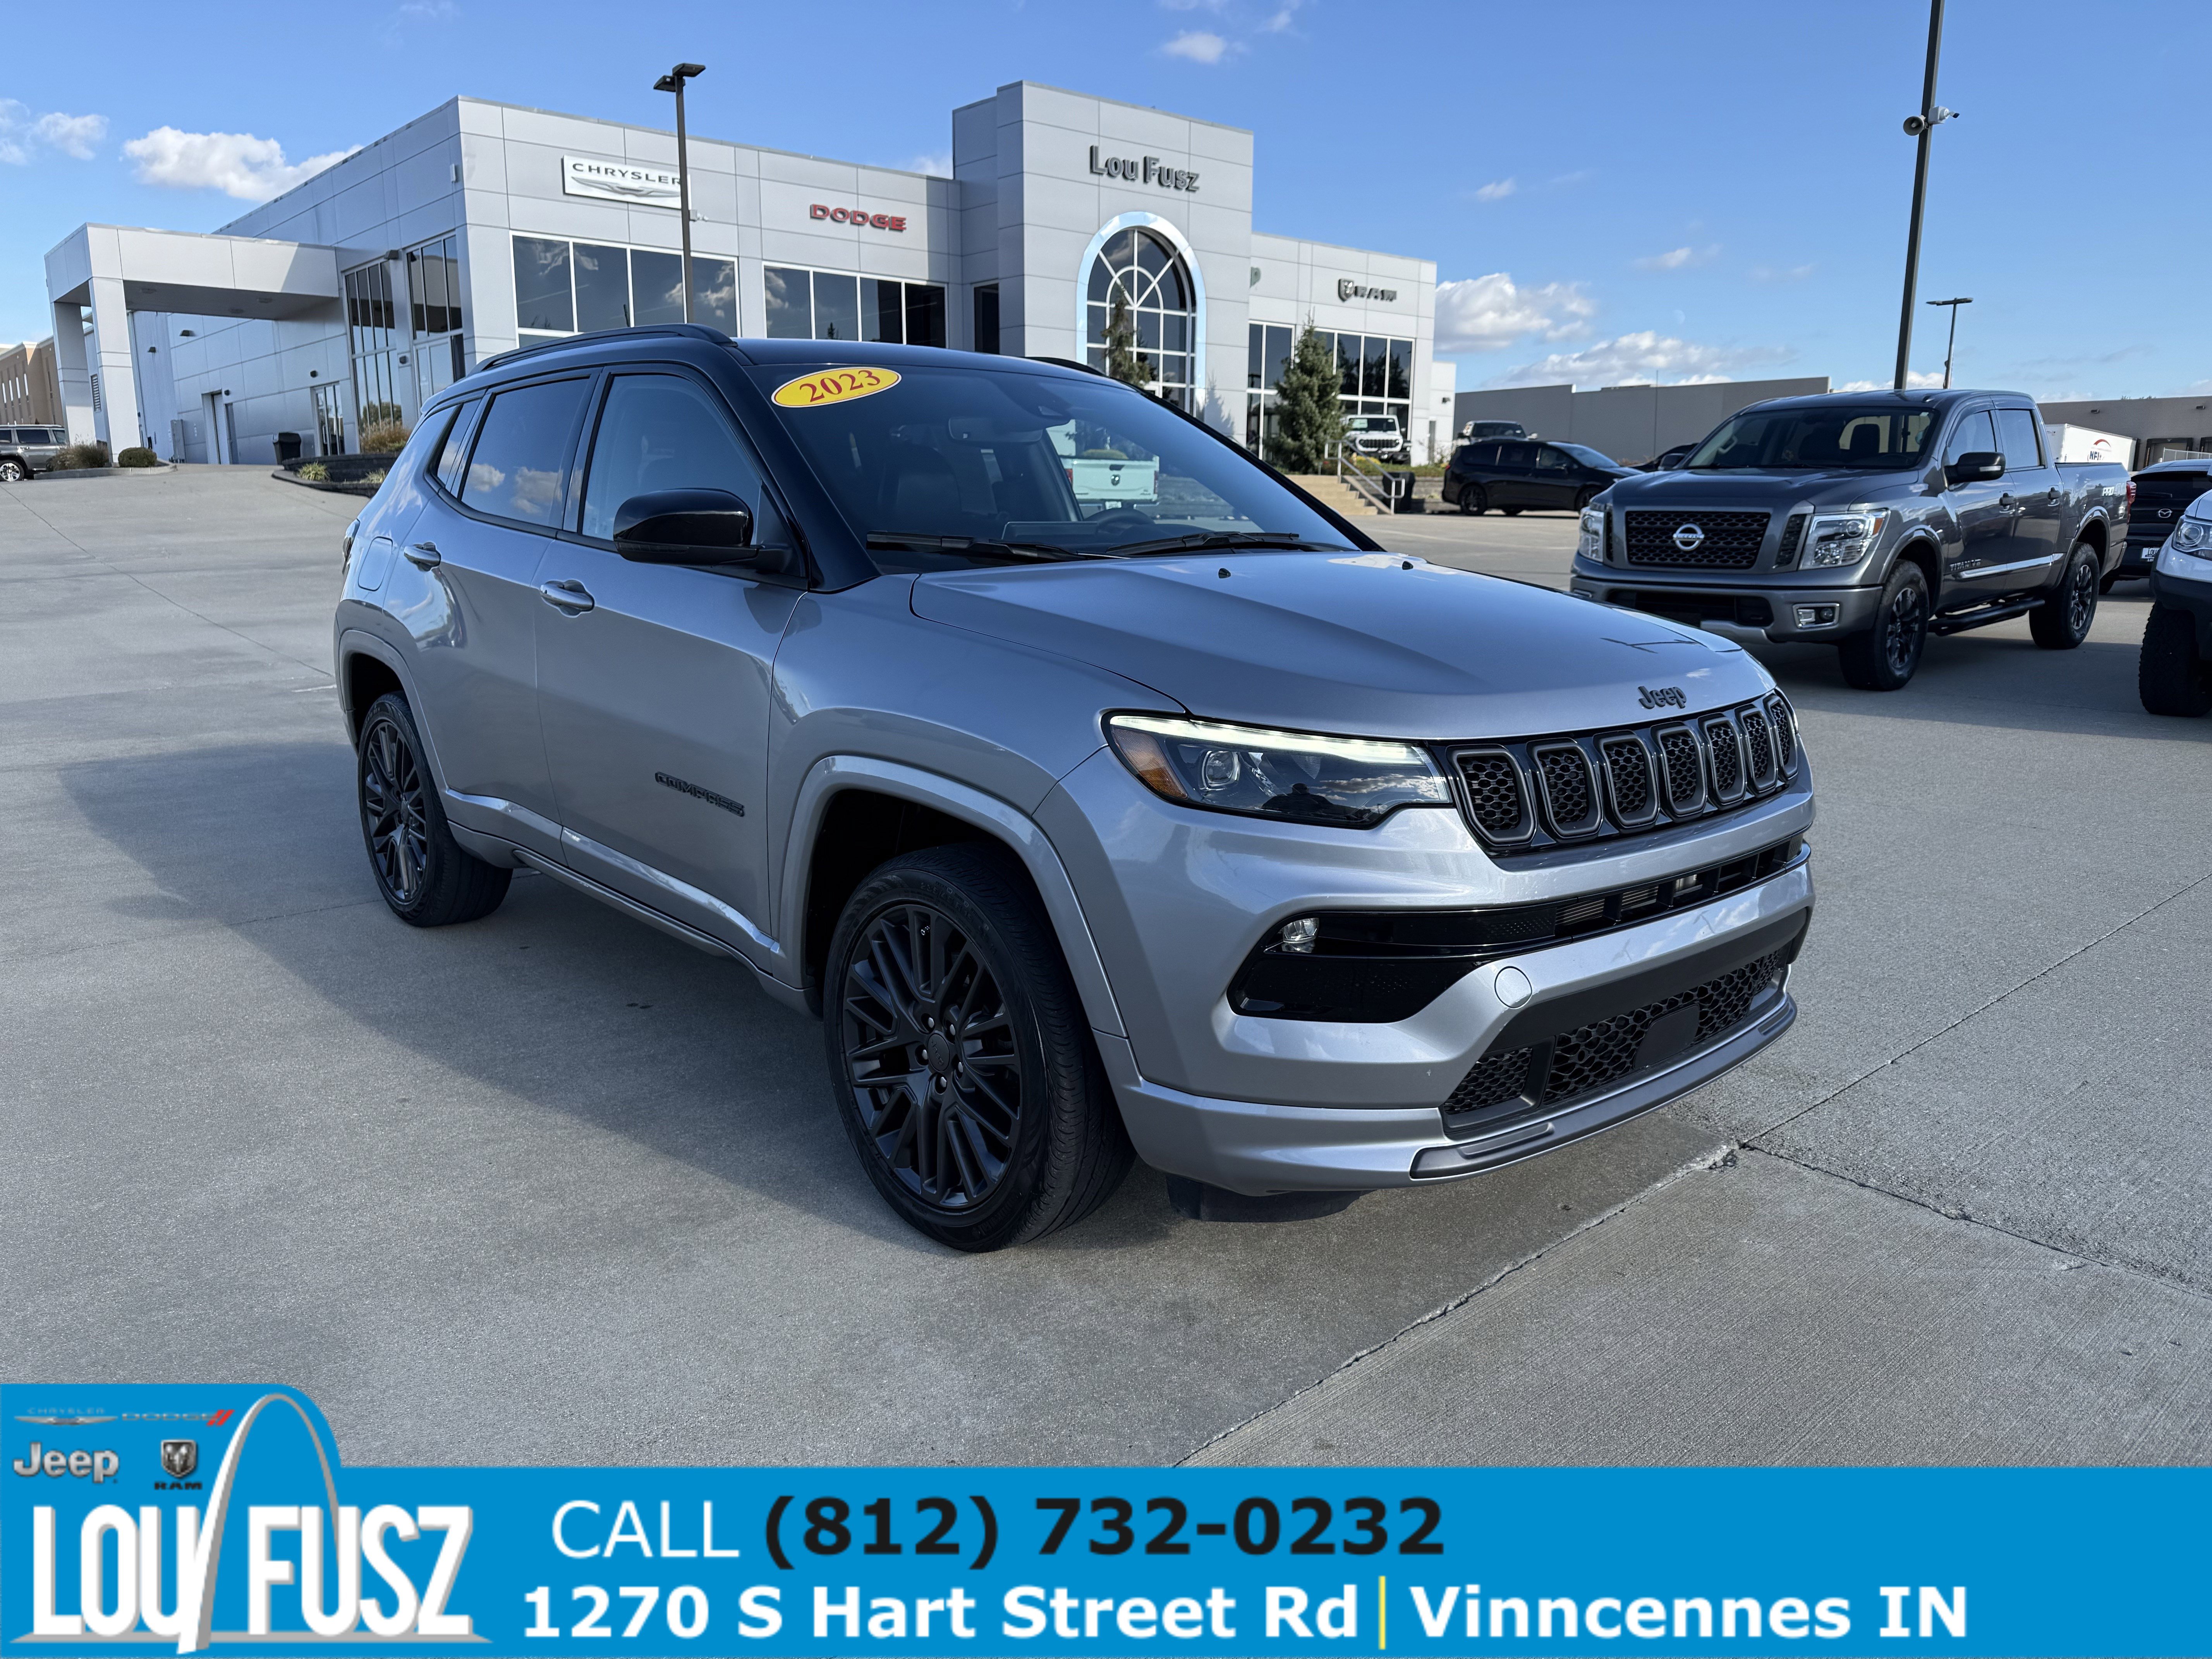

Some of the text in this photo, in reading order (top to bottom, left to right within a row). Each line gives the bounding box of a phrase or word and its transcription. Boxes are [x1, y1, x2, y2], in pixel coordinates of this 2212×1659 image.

[572, 163, 681, 185] CHRYSLER
[1090, 145, 1200, 193] Lou Fusz
[810, 204, 907, 233] DODGE
[1355, 286, 1397, 302] RAM
[799, 370, 881, 402] 2023
[1638, 686, 1687, 709] Jeep
[655, 771, 745, 817] COMPASS
